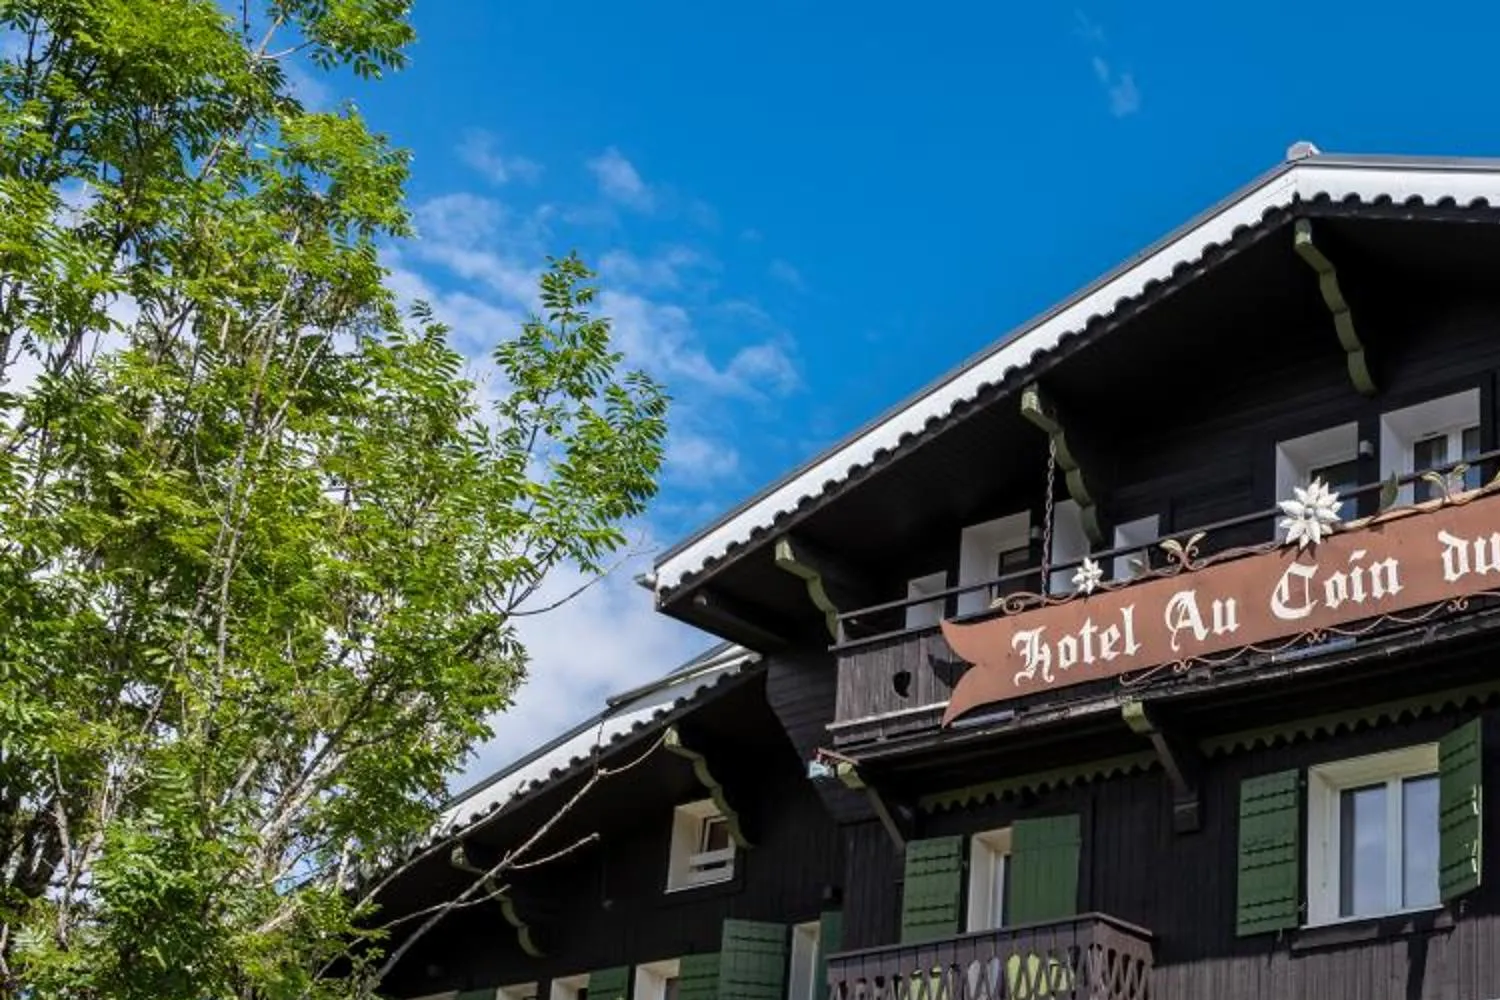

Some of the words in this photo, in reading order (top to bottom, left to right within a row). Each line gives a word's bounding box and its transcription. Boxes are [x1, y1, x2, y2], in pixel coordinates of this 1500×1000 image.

[1012, 604, 1141, 687] Hotel
[1165, 590, 1240, 652] Au
[1270, 549, 1403, 620] Coin
